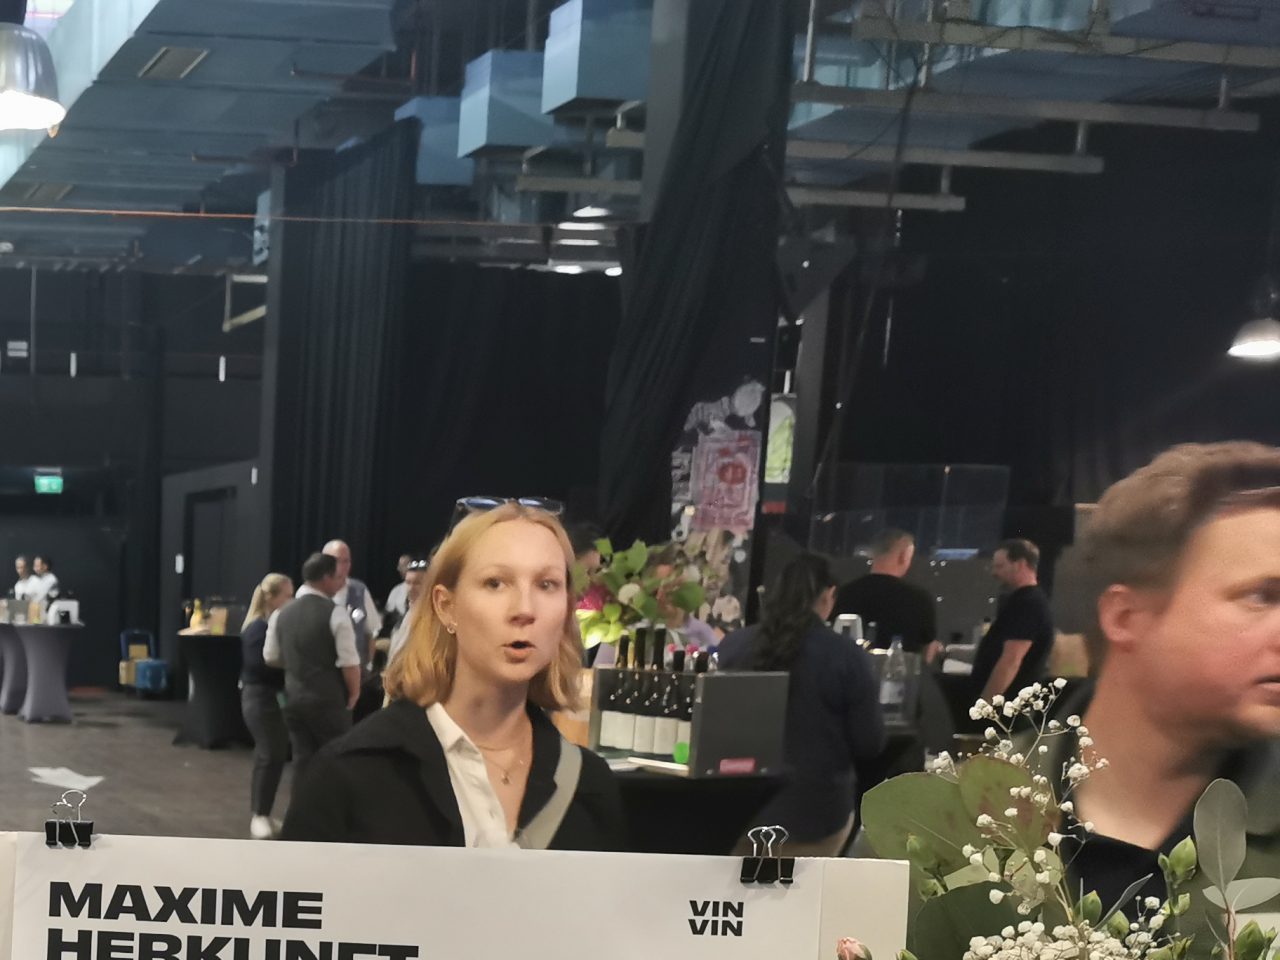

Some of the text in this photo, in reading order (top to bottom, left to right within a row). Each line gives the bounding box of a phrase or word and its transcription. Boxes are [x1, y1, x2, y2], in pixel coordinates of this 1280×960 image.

[48, 881, 324, 930] MAXIME
[689, 900, 745, 918] VIN
[688, 919, 744, 937] VIN
